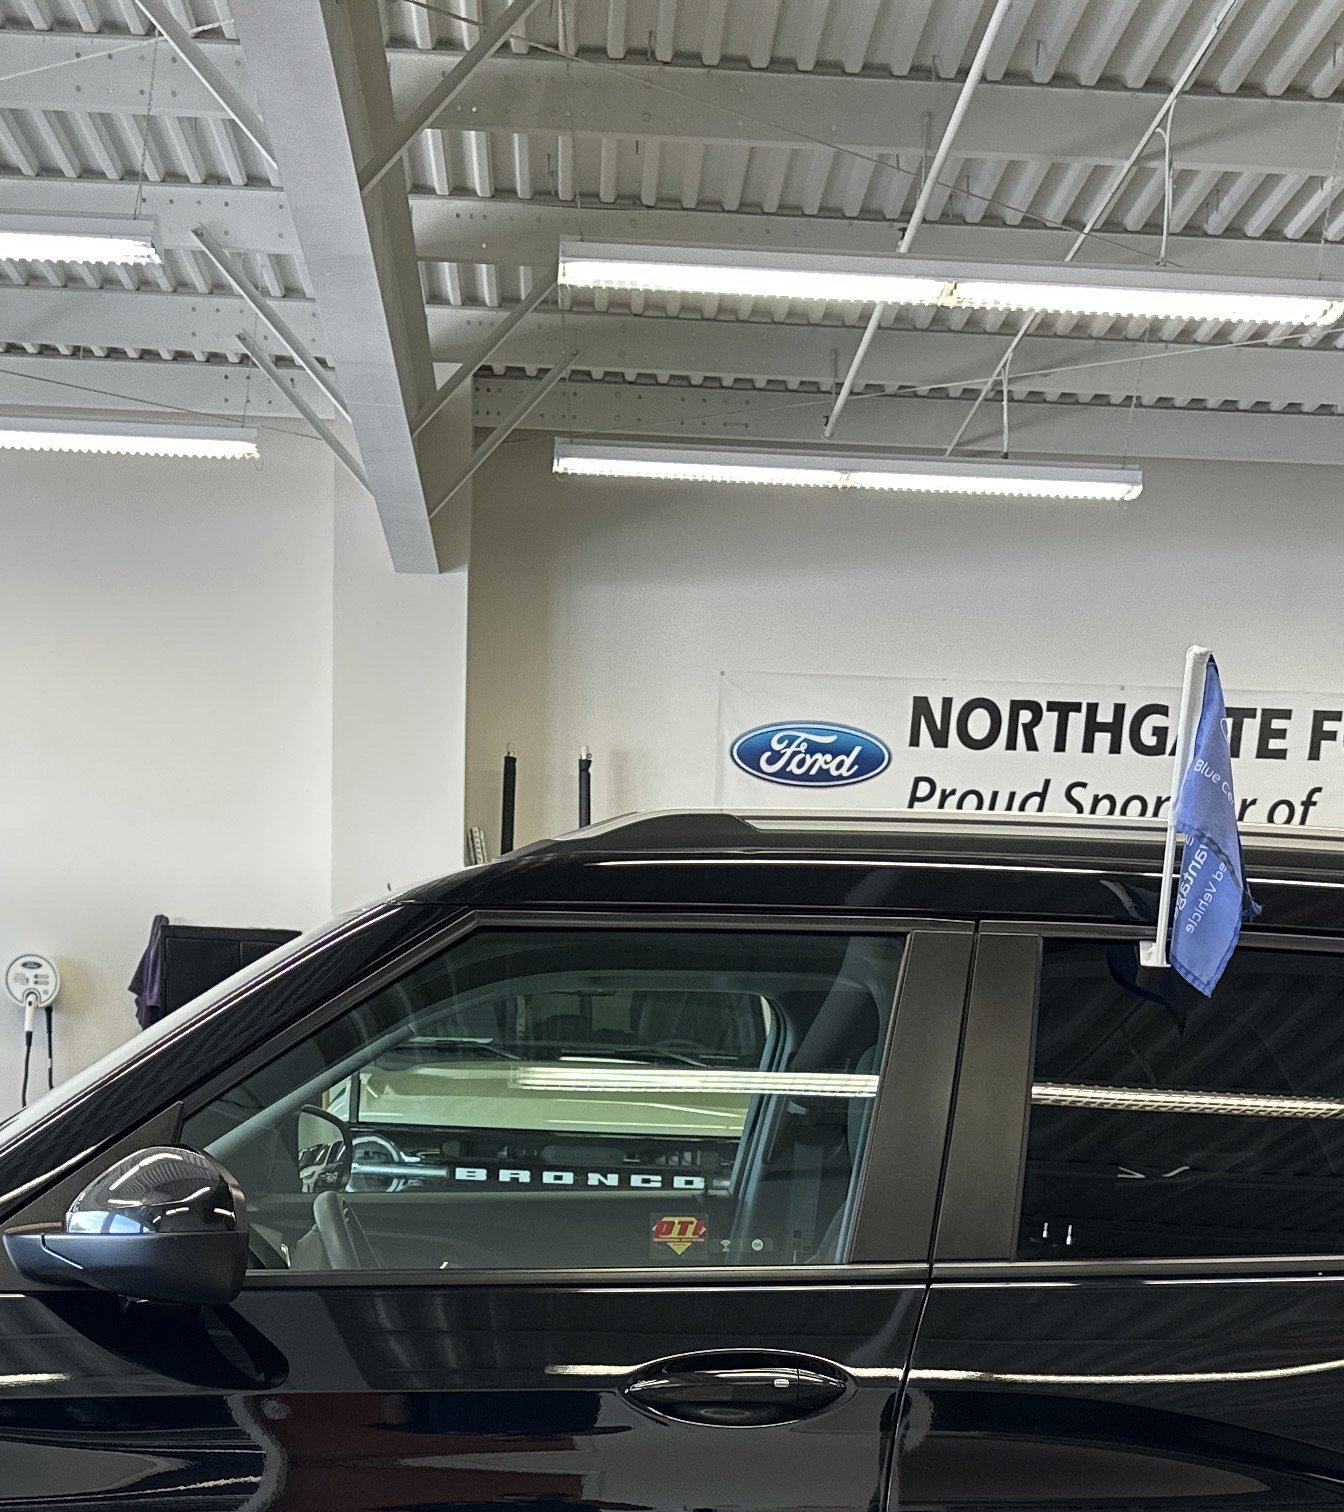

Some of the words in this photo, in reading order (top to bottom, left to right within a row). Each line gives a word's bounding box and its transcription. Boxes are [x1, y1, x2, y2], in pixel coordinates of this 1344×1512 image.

[908, 695, 1293, 761] NORTHGTE
[907, 775, 1052, 812] Proud
[1064, 781, 1258, 823] Spor
[1266, 786, 1323, 825] of
[455, 1167, 705, 1190] BRONCO
